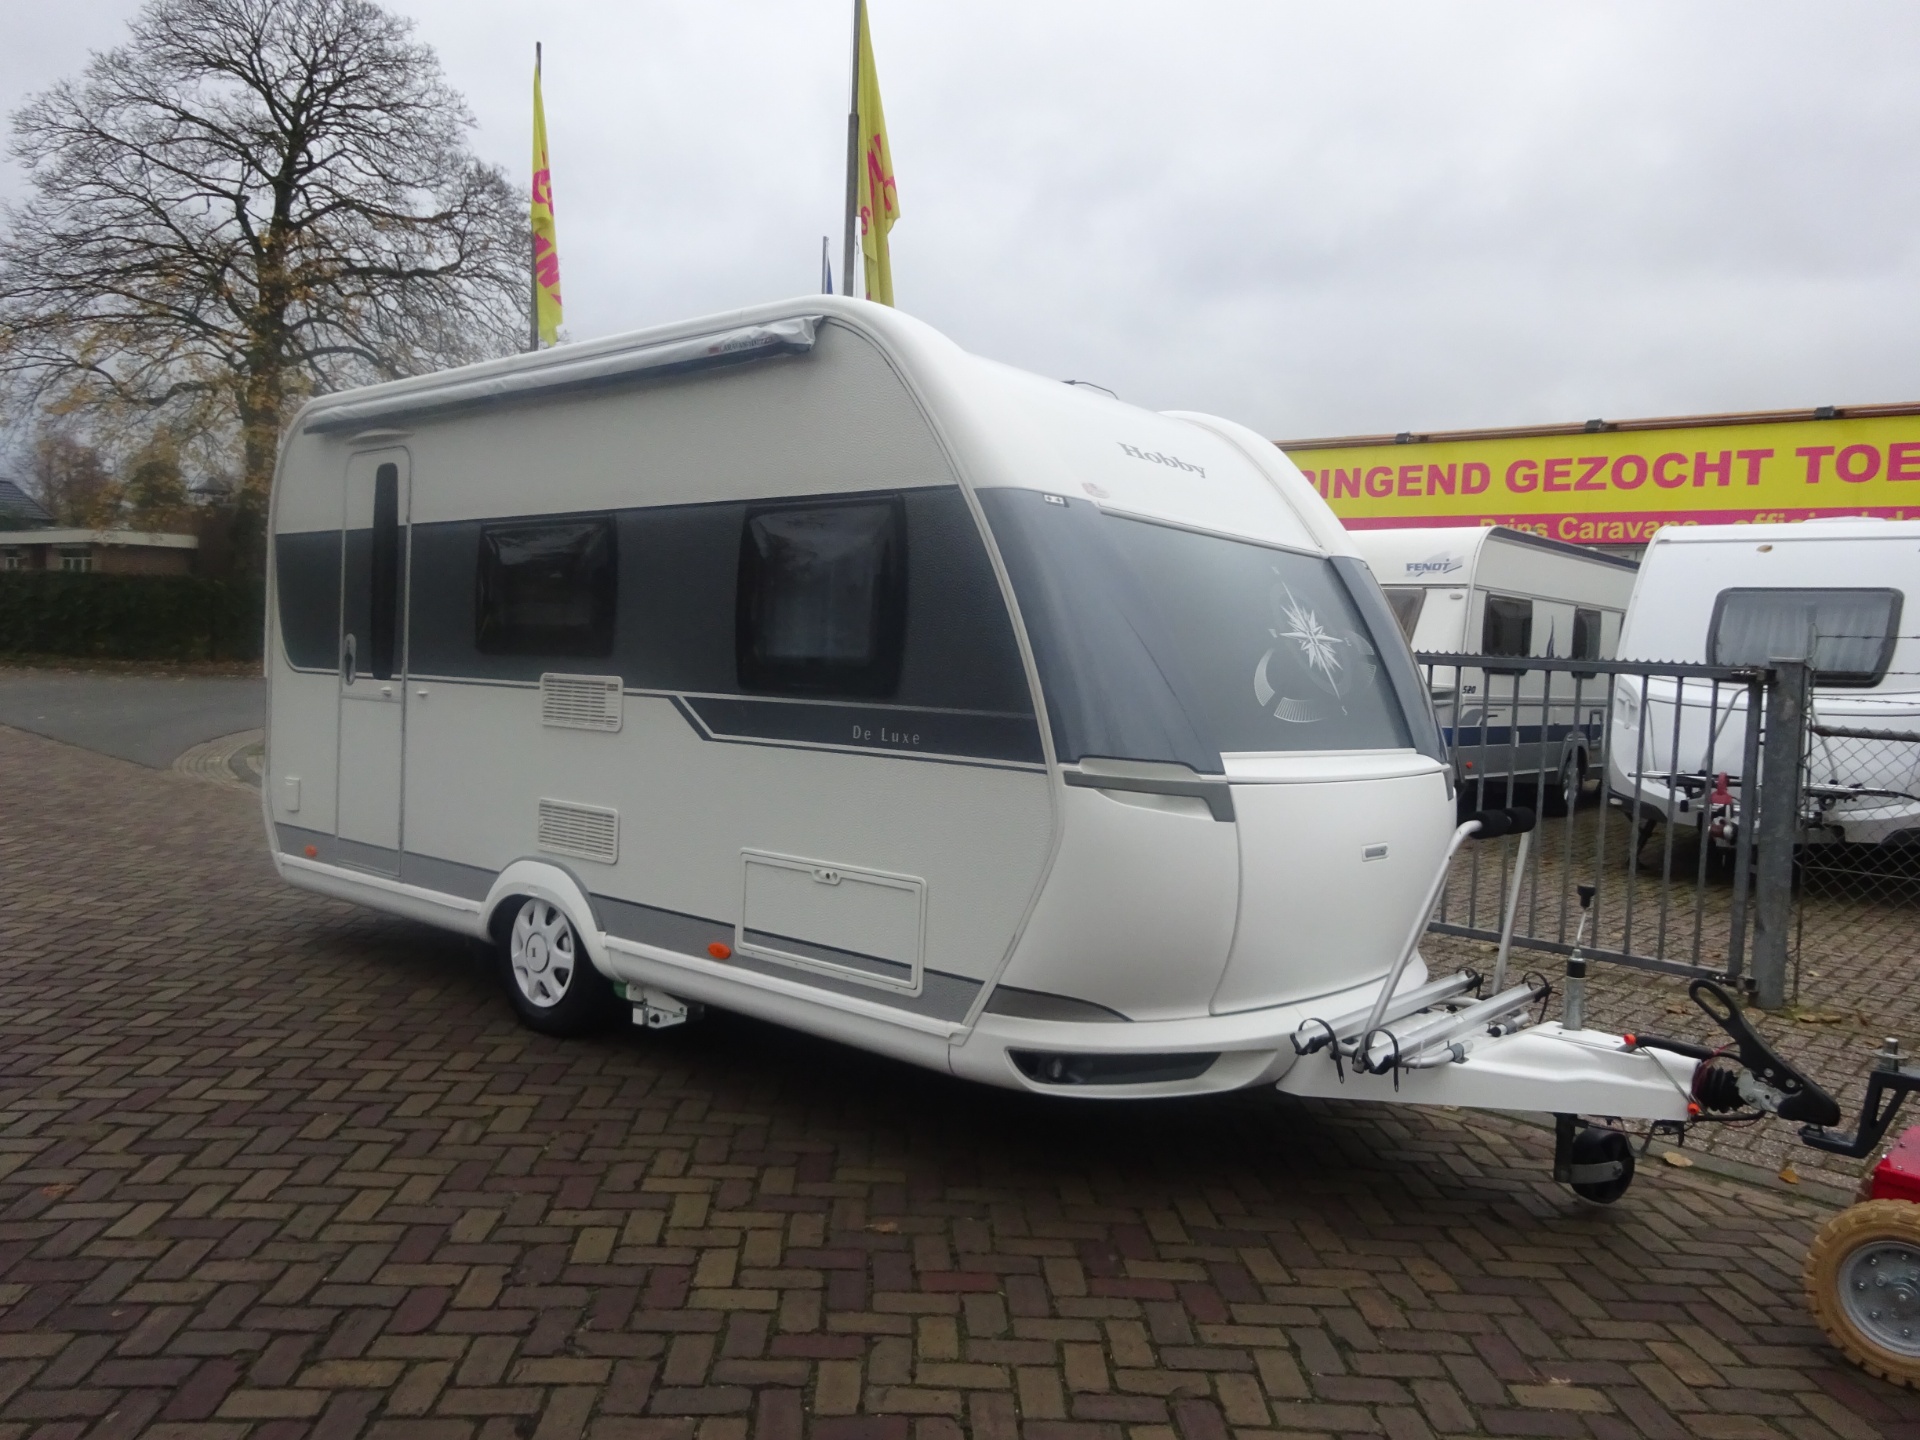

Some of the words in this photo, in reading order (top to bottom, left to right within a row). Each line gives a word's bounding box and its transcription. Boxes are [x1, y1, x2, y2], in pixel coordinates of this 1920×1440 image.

[1116, 441, 1206, 479] Hobby
[1505, 447, 1774, 493] GEZOCHT
[1558, 516, 1699, 540] Carava
[1406, 561, 1452, 572] FENDT
[1462, 685, 1477, 694] 520
[852, 725, 871, 741] De
[881, 727, 920, 745] Luxe
